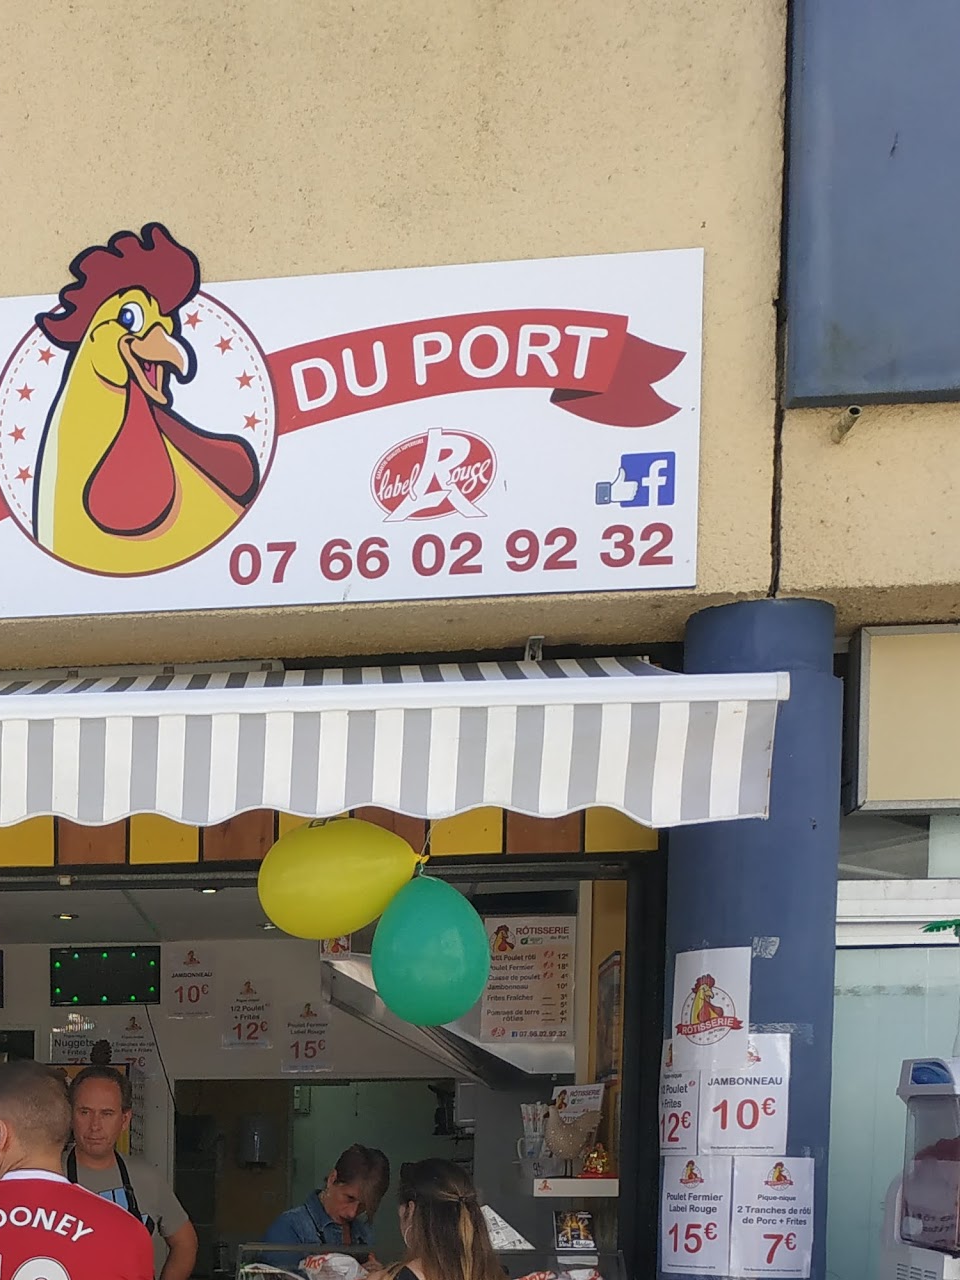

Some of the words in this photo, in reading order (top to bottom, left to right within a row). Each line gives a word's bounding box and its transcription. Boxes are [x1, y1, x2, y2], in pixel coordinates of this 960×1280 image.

[291, 340, 388, 412] DU
[412, 324, 608, 386] PORT
[228, 541, 298, 586] 07
[319, 536, 390, 582] 66
[412, 531, 484, 577] 02
[505, 526, 578, 573] 92
[600, 522, 674, 568] 32
[516, 925, 570, 935] RÔTISSERIE
[174, 984, 209, 1003] 10€
[232, 1021, 268, 1040] 12€
[54, 1039, 94, 1048] Nuggets
[290, 1040, 326, 1059] 15€
[707, 1077, 783, 1087] JAMBONNEAU
[712, 1097, 776, 1130] 10€
[667, 1193, 686, 1201] Poulet
[688, 1193, 723, 1201] Fermier
[669, 1204, 687, 1212] Label
[689, 1205, 717, 1214] Rouge
[746, 1206, 786, 1214] Tranches
[799, 1206, 811, 1214] rôti
[786, 1217, 807, 1225] Frites
[669, 1222, 717, 1253] 15€
[763, 1232, 796, 1264] 7€
